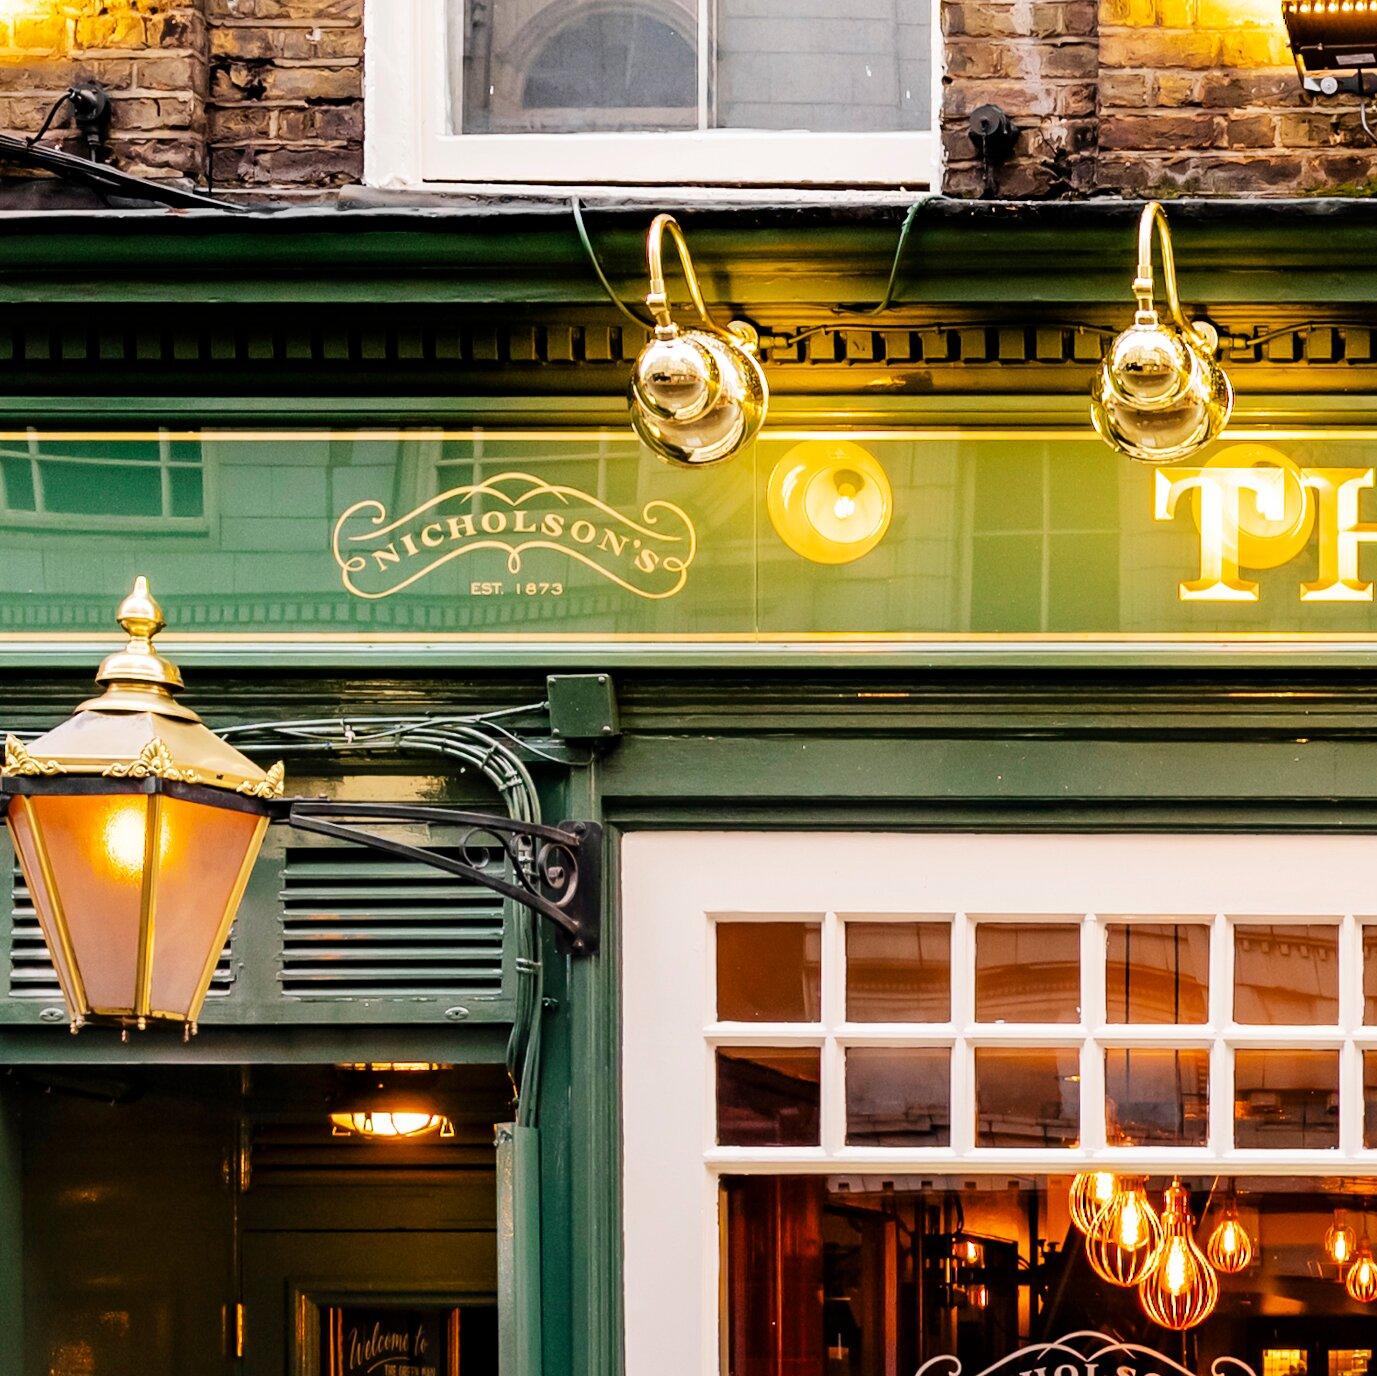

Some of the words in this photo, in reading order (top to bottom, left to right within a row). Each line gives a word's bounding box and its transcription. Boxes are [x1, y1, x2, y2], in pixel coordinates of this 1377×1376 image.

[371, 510, 660, 574] NICHOLSON'S
[470, 582, 503, 595] EST.
[515, 582, 563, 595] 1873
[349, 1321, 409, 1370] Welcome
[414, 1325, 428, 1356] to
